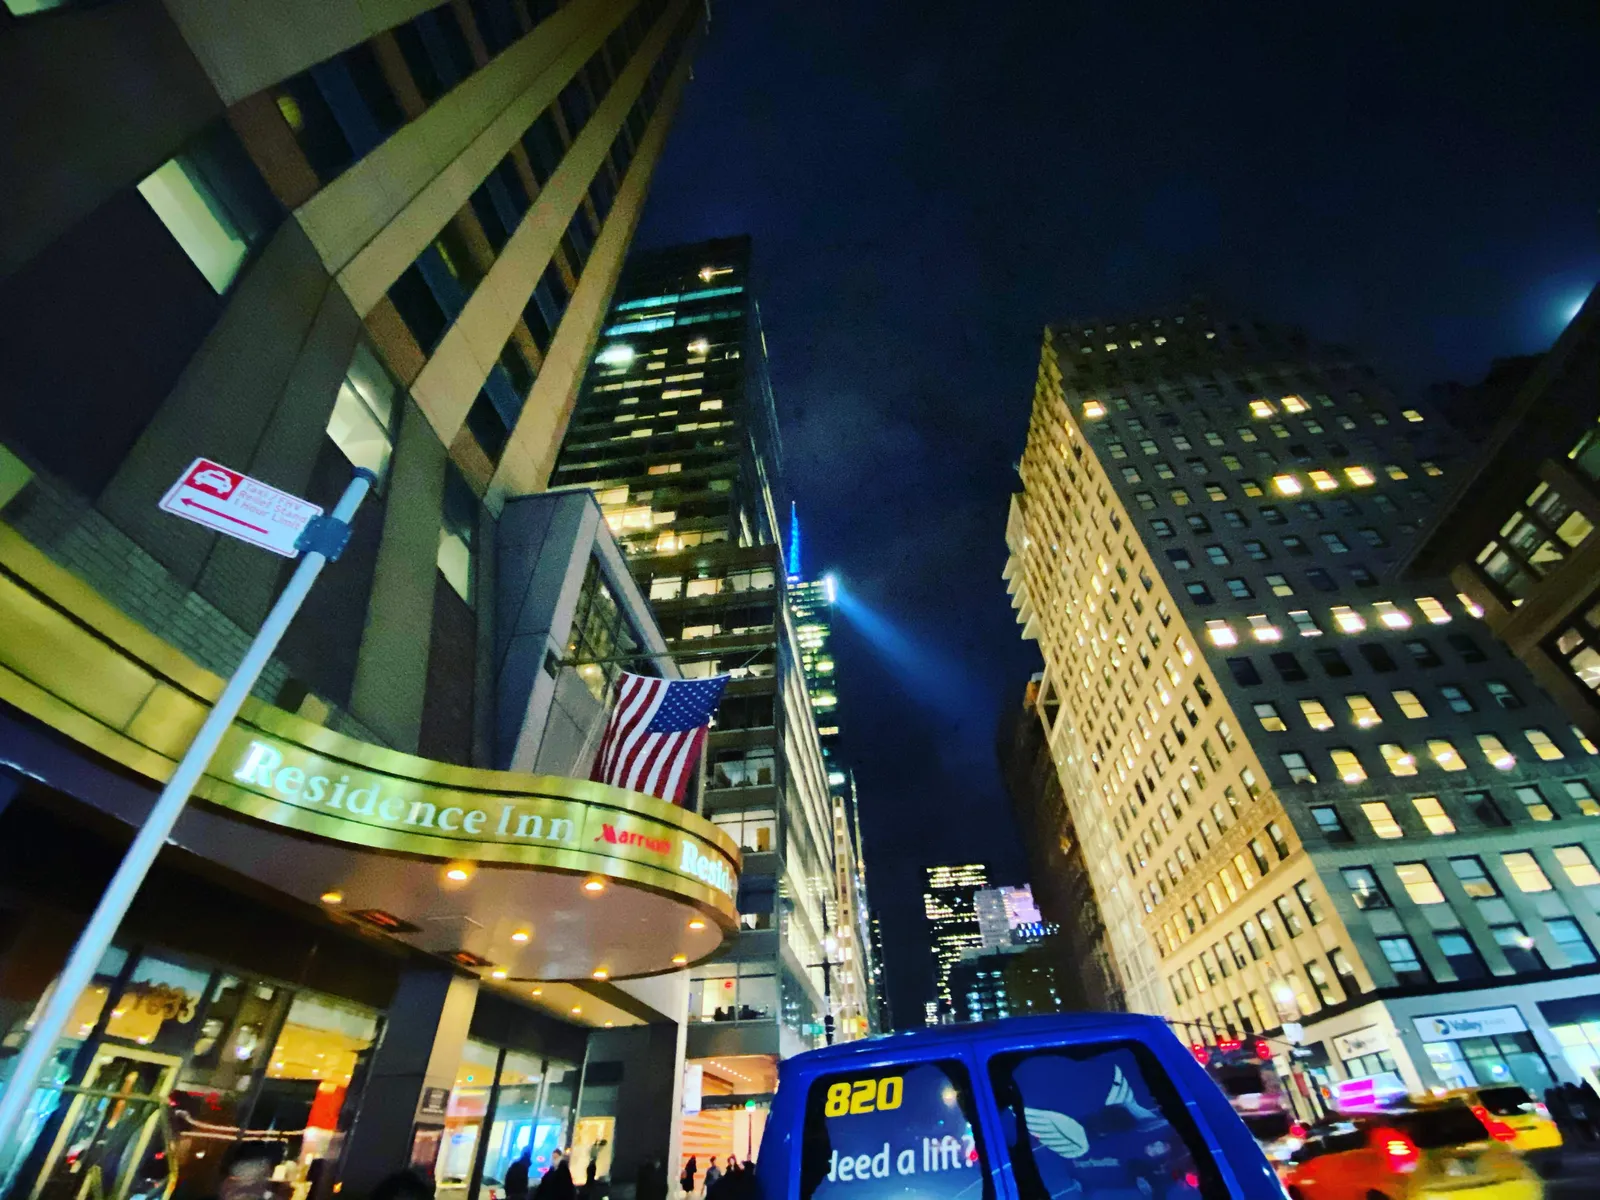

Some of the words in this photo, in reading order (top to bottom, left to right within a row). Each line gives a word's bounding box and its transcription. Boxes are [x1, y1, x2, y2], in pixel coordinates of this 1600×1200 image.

[234, 740, 487, 835] Residence
[495, 805, 575, 843] Inn
[824, 1076, 904, 1118] 820
[896, 1149, 916, 1175] a
[922, 1134, 976, 1172] lift?
